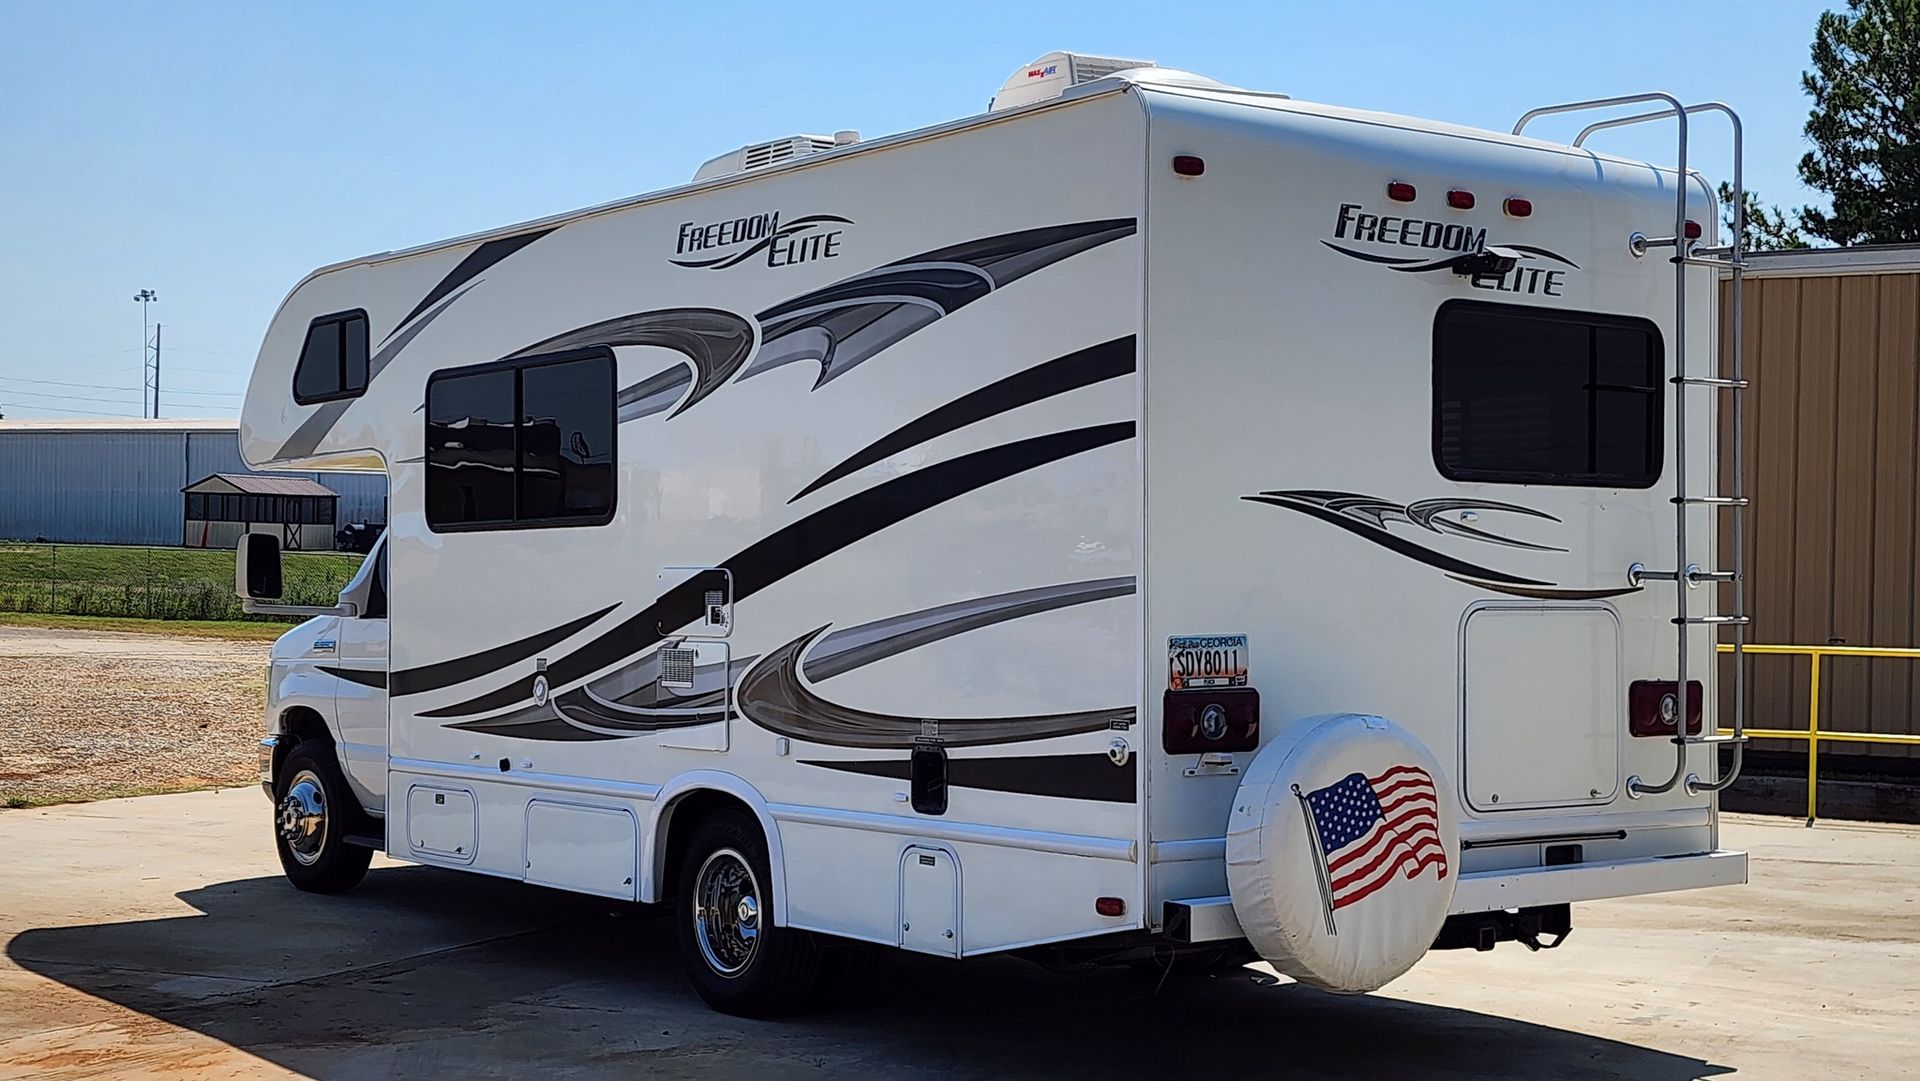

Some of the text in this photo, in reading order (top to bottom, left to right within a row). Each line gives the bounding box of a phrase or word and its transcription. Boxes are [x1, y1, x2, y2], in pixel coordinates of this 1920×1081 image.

[676, 211, 780, 254] FREEDOM
[1334, 203, 1487, 256] FREEDOM
[767, 230, 842, 268] ELITE
[1200, 636, 1243, 648] GEORGIA
[1176, 649, 1238, 676] SDY8011
